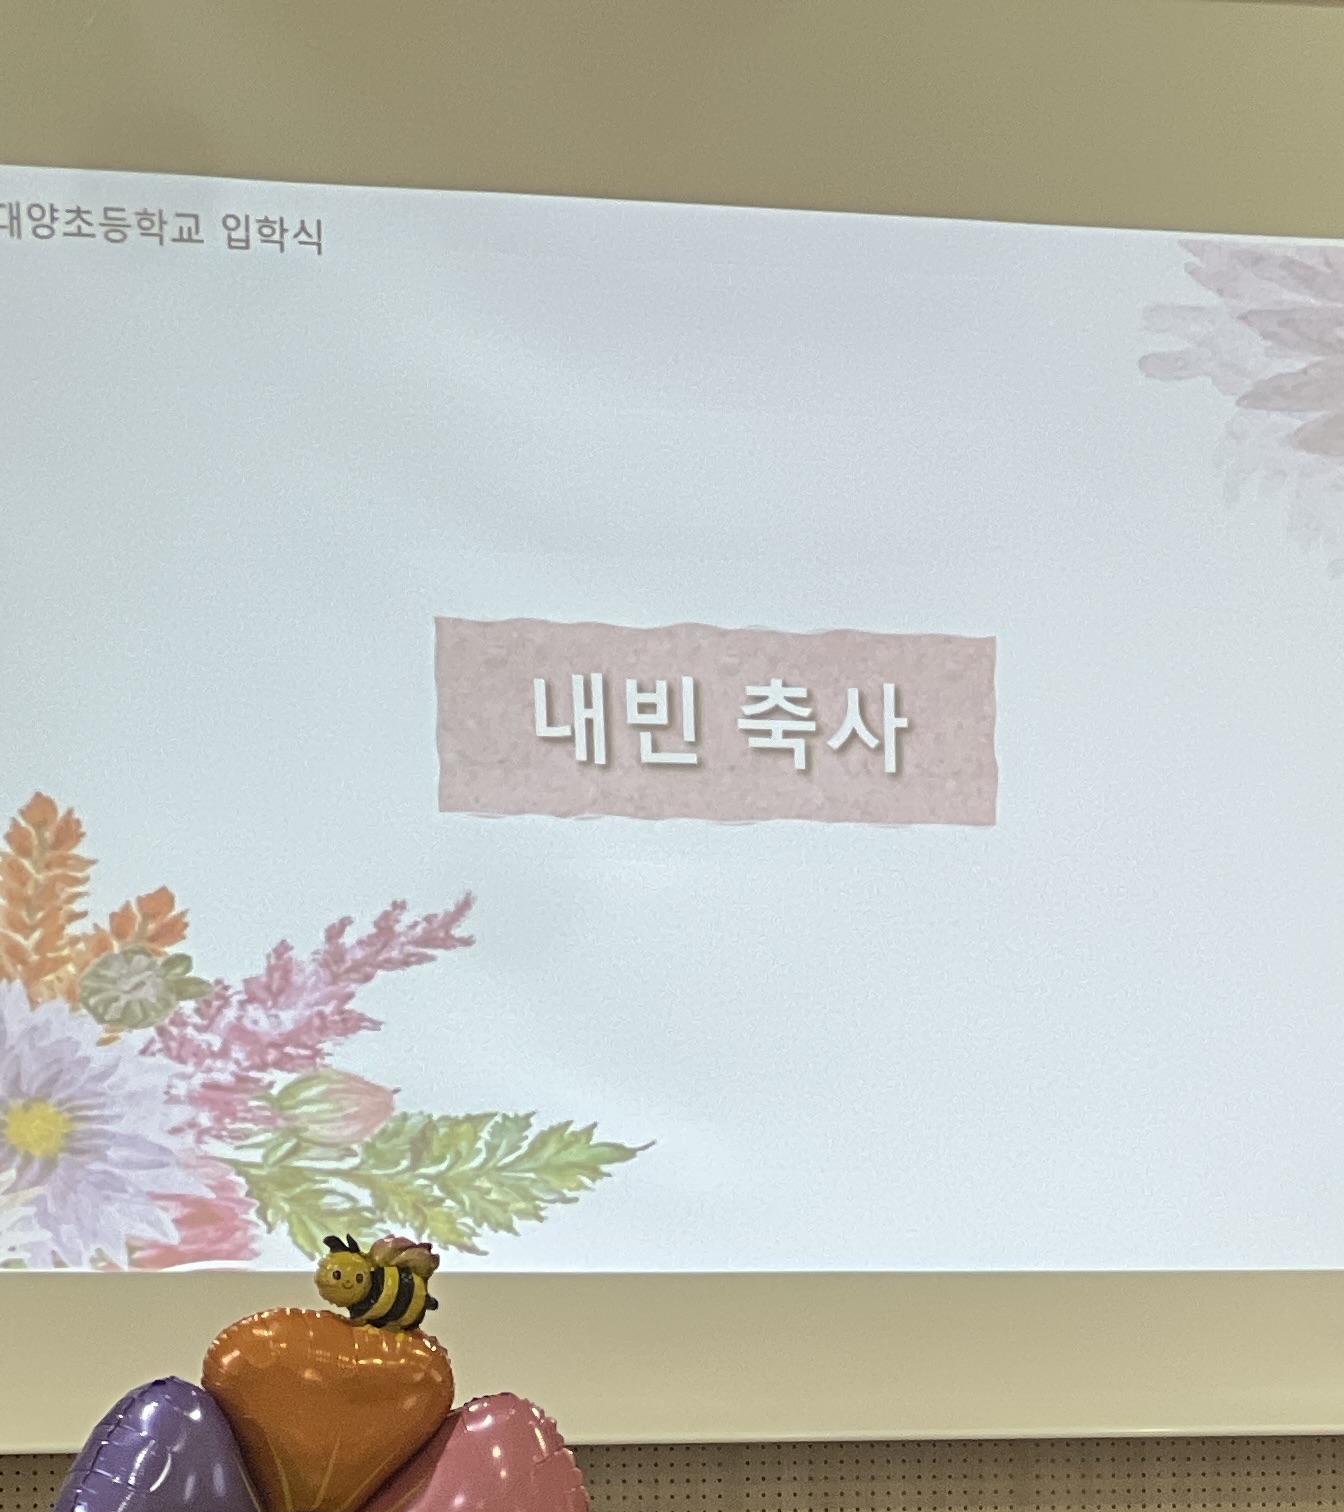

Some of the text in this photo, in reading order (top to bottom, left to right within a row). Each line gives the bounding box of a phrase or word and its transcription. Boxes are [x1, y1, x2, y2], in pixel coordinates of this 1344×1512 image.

[0, 201, 323, 256] 대양초등학교 입학식
[532, 671, 908, 774] 내빈 축사
